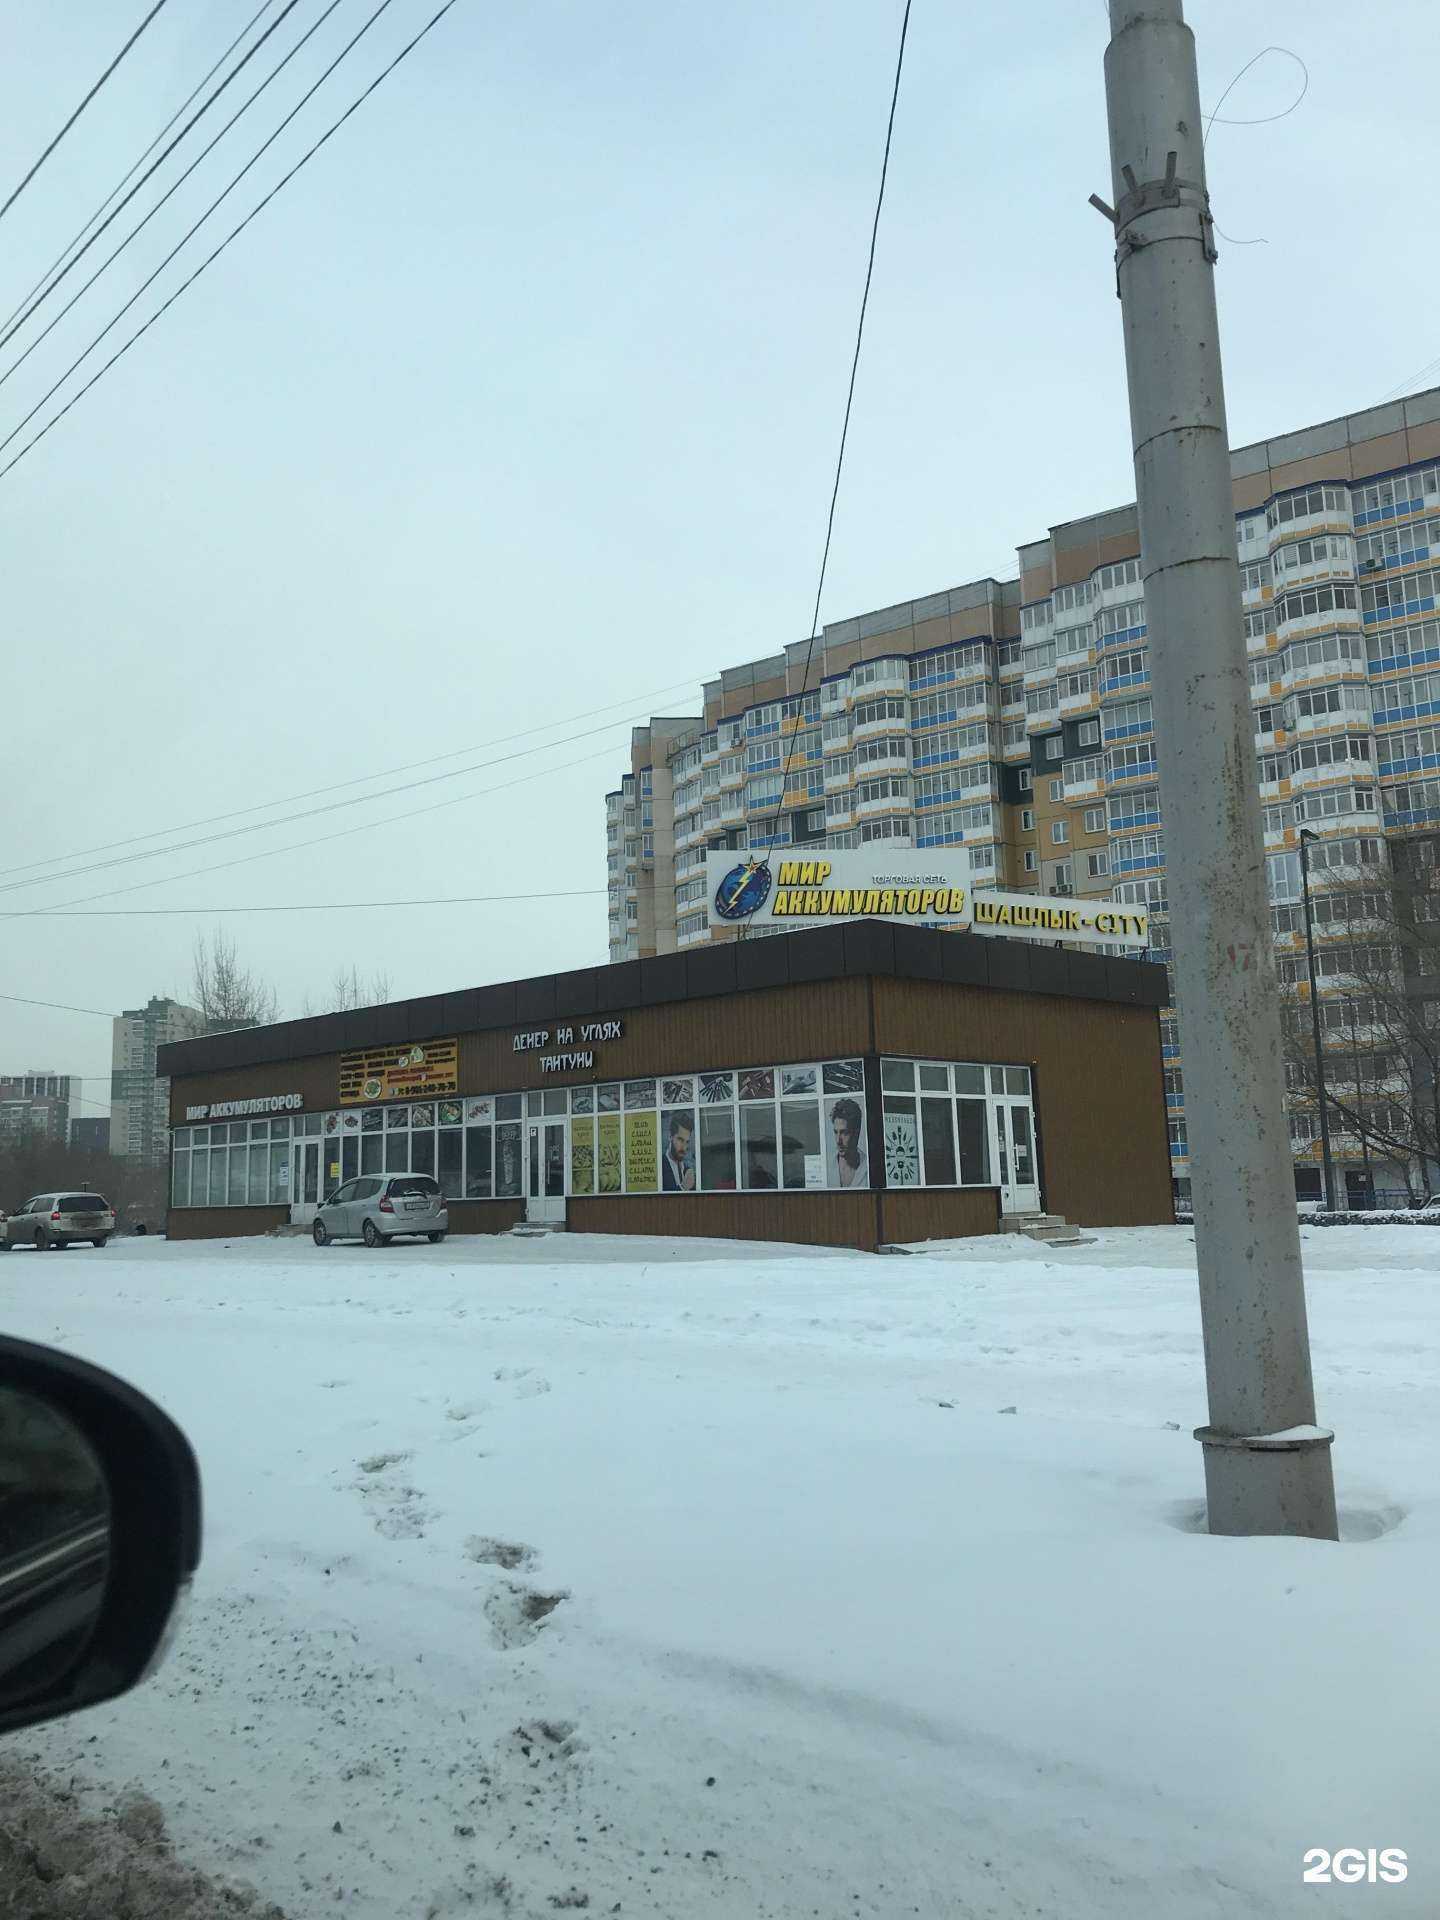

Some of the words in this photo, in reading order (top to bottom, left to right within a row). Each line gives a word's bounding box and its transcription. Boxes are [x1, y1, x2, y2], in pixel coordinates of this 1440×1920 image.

[777, 861, 831, 886] МИР
[872, 875, 920, 884] ТОРГОВАЯ
[924, 875, 947, 884] СЕТЬ
[772, 888, 964, 916] АККУМУЛЯТОРОВ
[512, 1031, 549, 1051] ДЕНЕР
[557, 1027, 574, 1045] НА
[581, 1020, 621, 1042] УГЛЯХ
[539, 1051, 593, 1073] ТАНТУНИ
[186, 1105, 209, 1120] МИР
[209, 1094, 303, 1118] АККУМУЛЯТОРОВ
